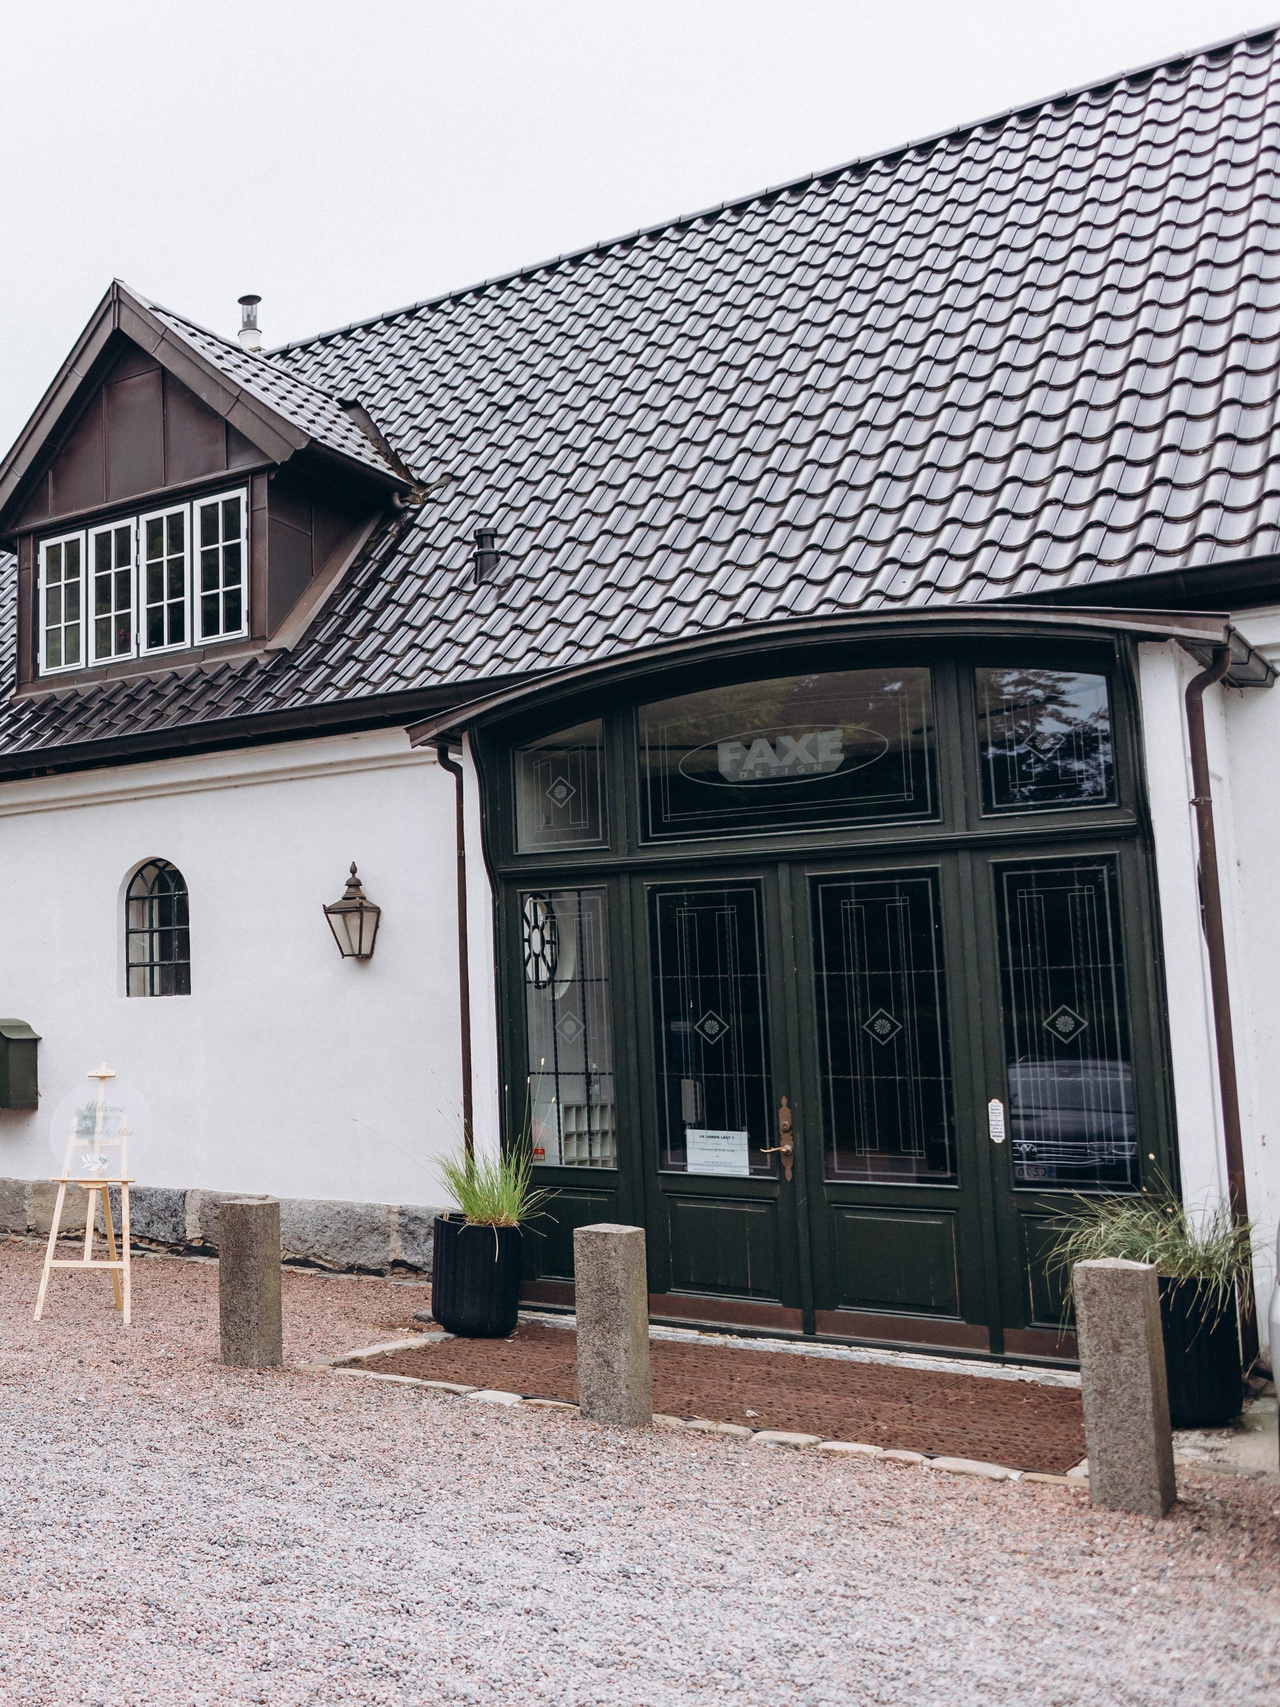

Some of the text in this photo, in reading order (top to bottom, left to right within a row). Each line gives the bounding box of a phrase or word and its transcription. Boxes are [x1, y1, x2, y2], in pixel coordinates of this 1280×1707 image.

[718, 730, 845, 772] FAXE
[739, 765, 822, 778] DESIGN
[84, 1100, 127, 1112] Welcome
